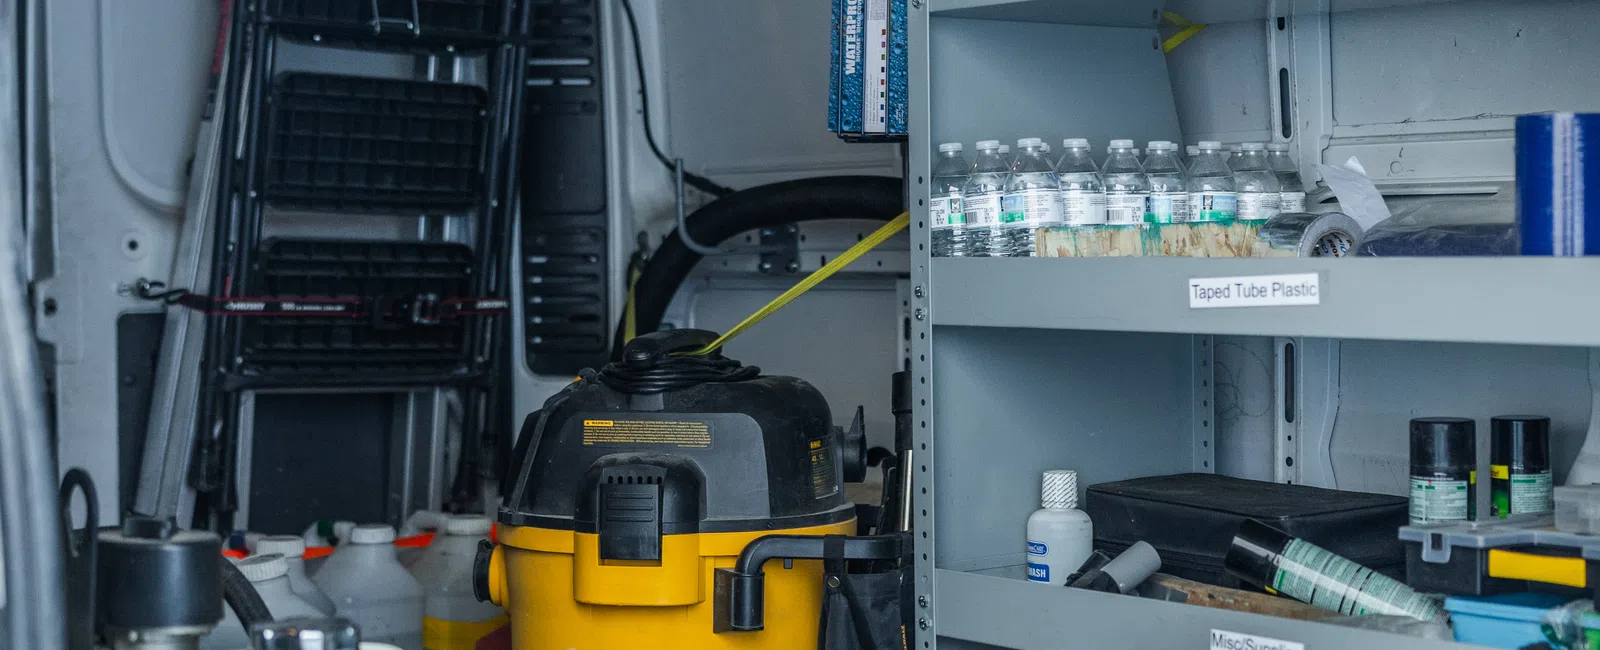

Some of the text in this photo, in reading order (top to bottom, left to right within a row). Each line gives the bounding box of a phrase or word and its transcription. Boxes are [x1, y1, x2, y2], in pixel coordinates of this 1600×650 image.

[1192, 281, 1318, 302] Taped Tube Plastic
